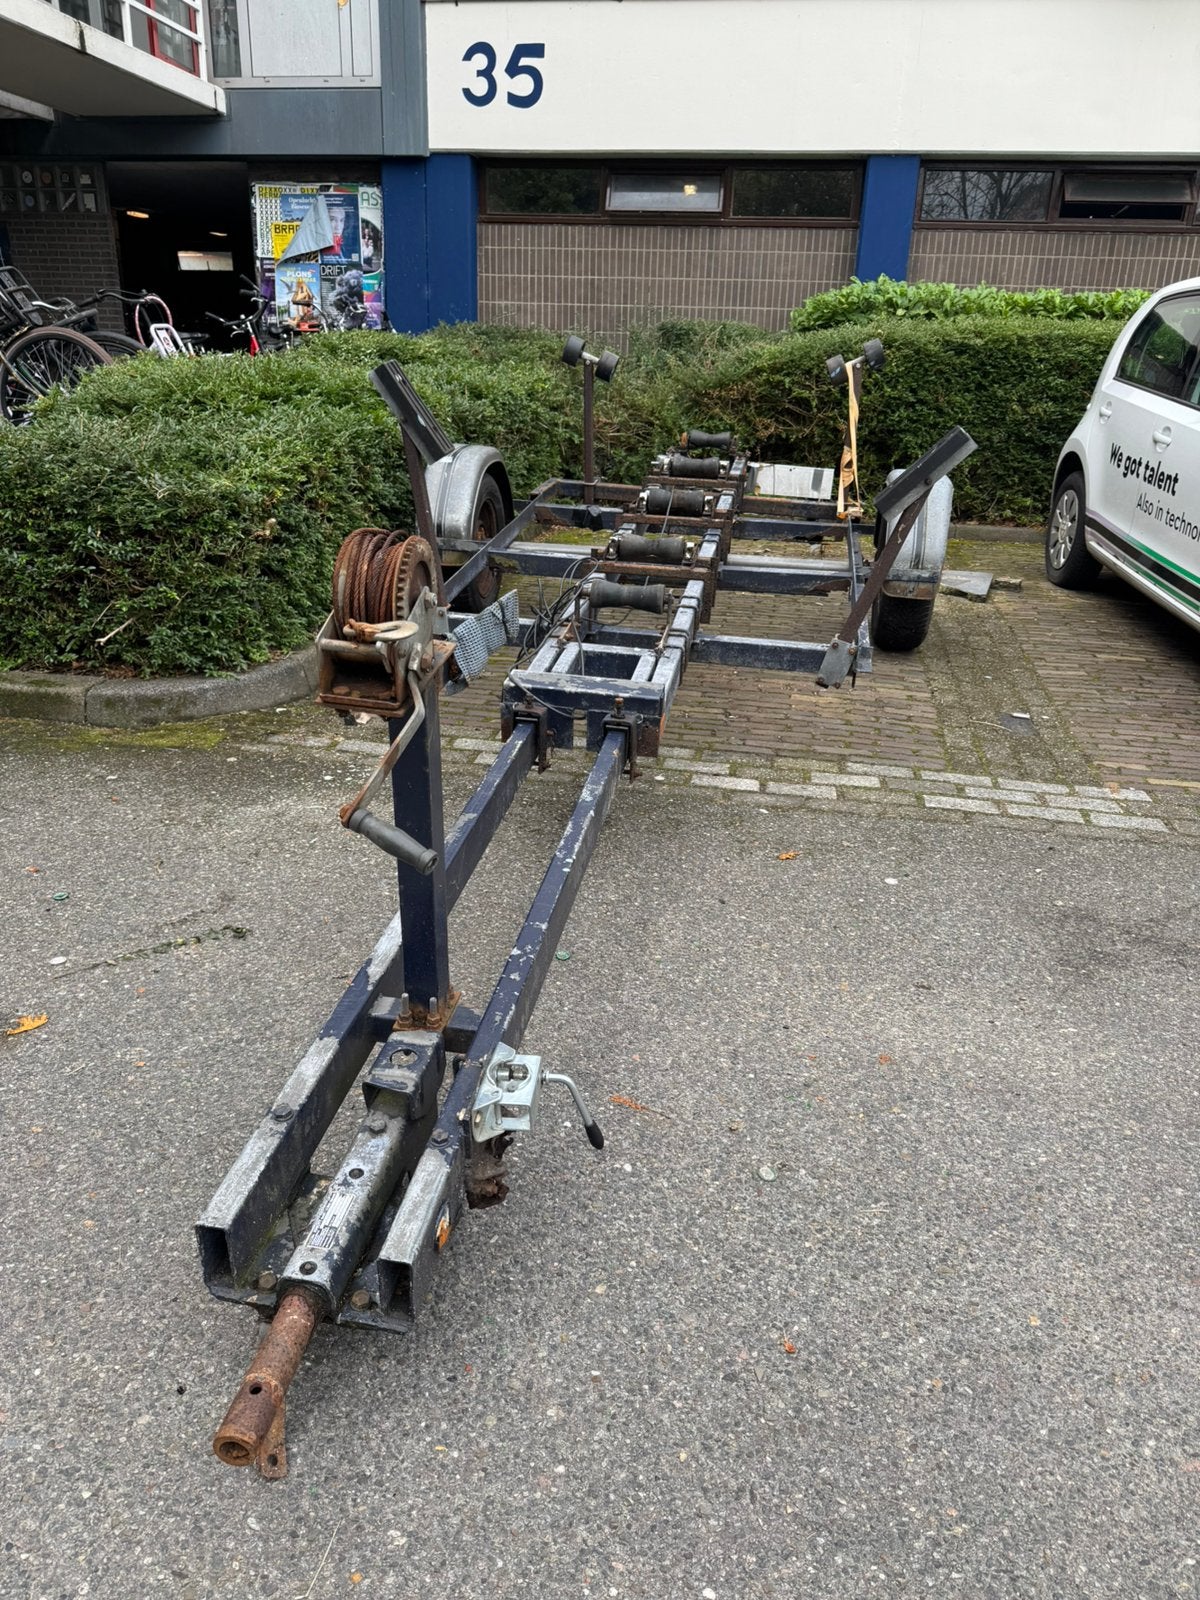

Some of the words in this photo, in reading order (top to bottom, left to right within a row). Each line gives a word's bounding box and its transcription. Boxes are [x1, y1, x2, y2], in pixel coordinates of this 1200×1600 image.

[461, 41, 545, 108] 35
[320, 265, 347, 276] DRIFT
[1110, 442, 1123, 468] We
[1122, 455, 1142, 478] got
[1143, 460, 1179, 496] talent
[1136, 492, 1153, 515] Also
[1155, 499, 1163, 522] in
